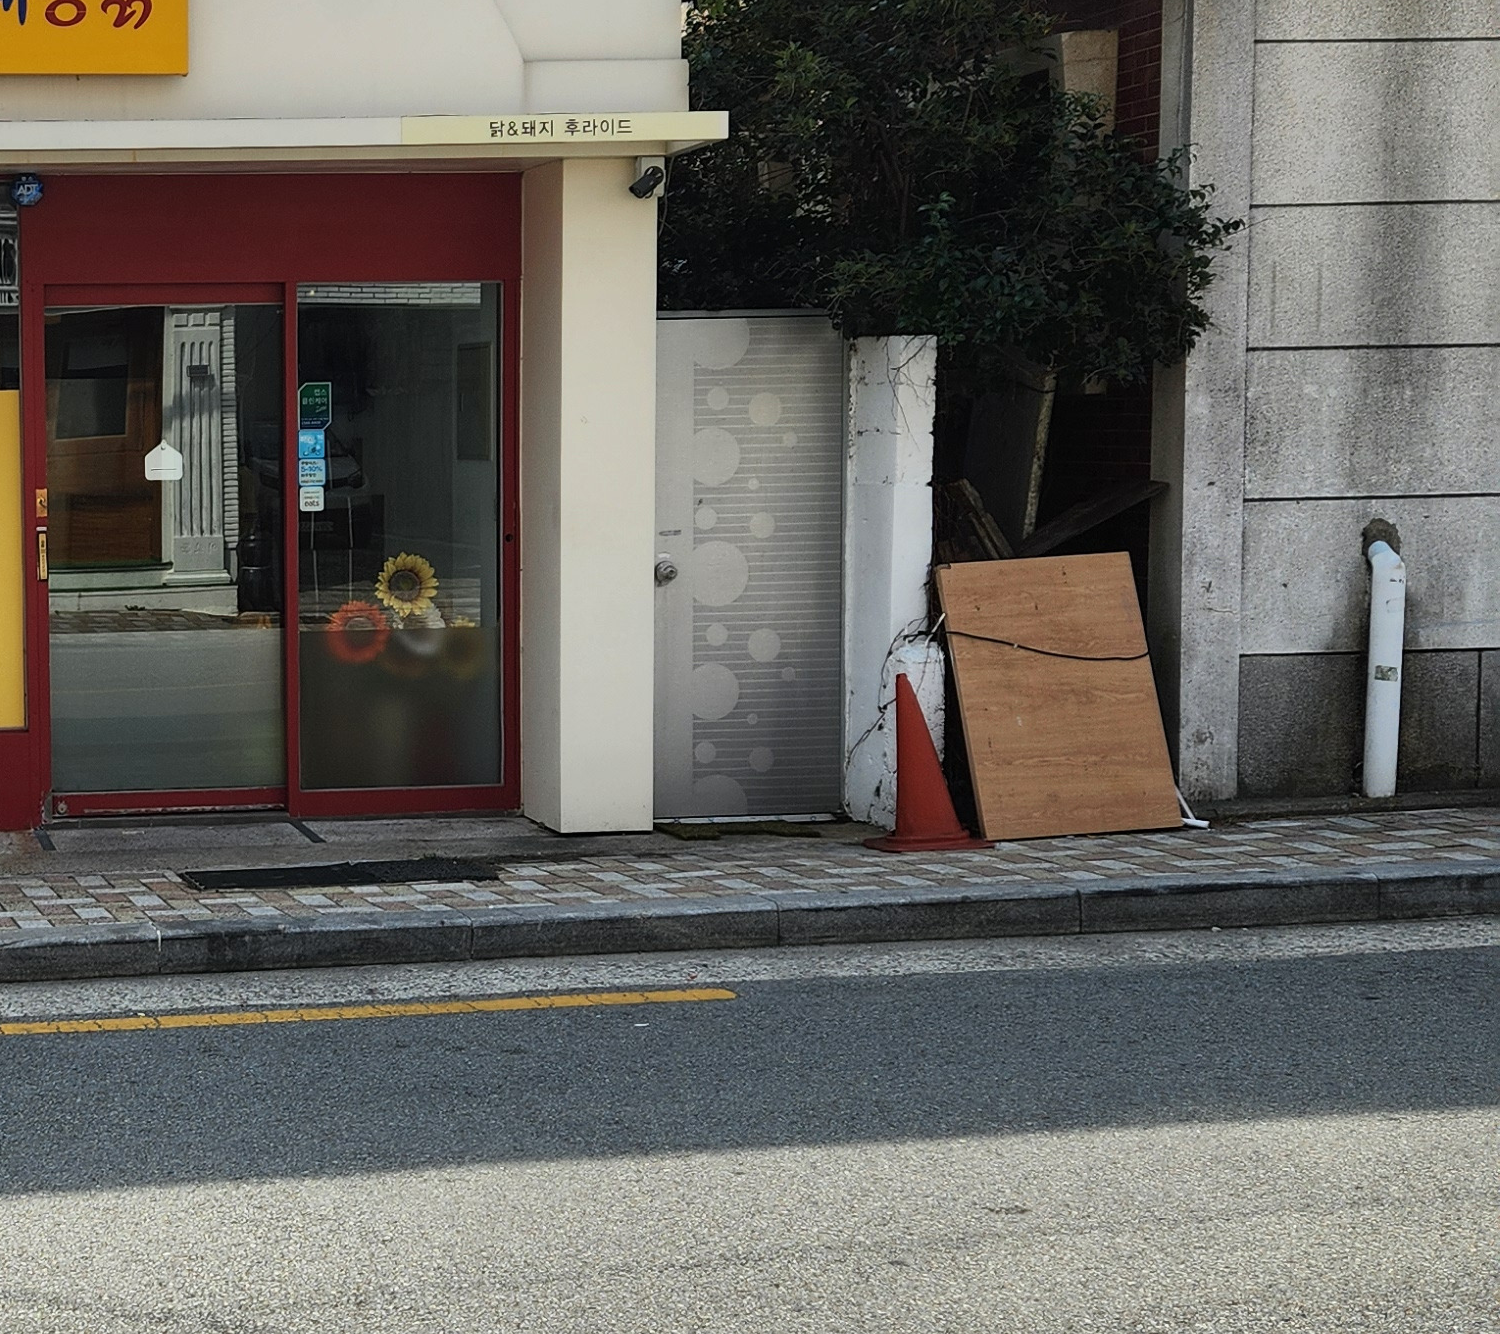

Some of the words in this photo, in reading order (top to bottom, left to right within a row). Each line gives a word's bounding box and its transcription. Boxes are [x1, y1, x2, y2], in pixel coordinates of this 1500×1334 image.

[489, 119, 554, 138] 닭&돼지
[564, 118, 633, 136] 후라이드
[17, 184, 38, 195] ADT
